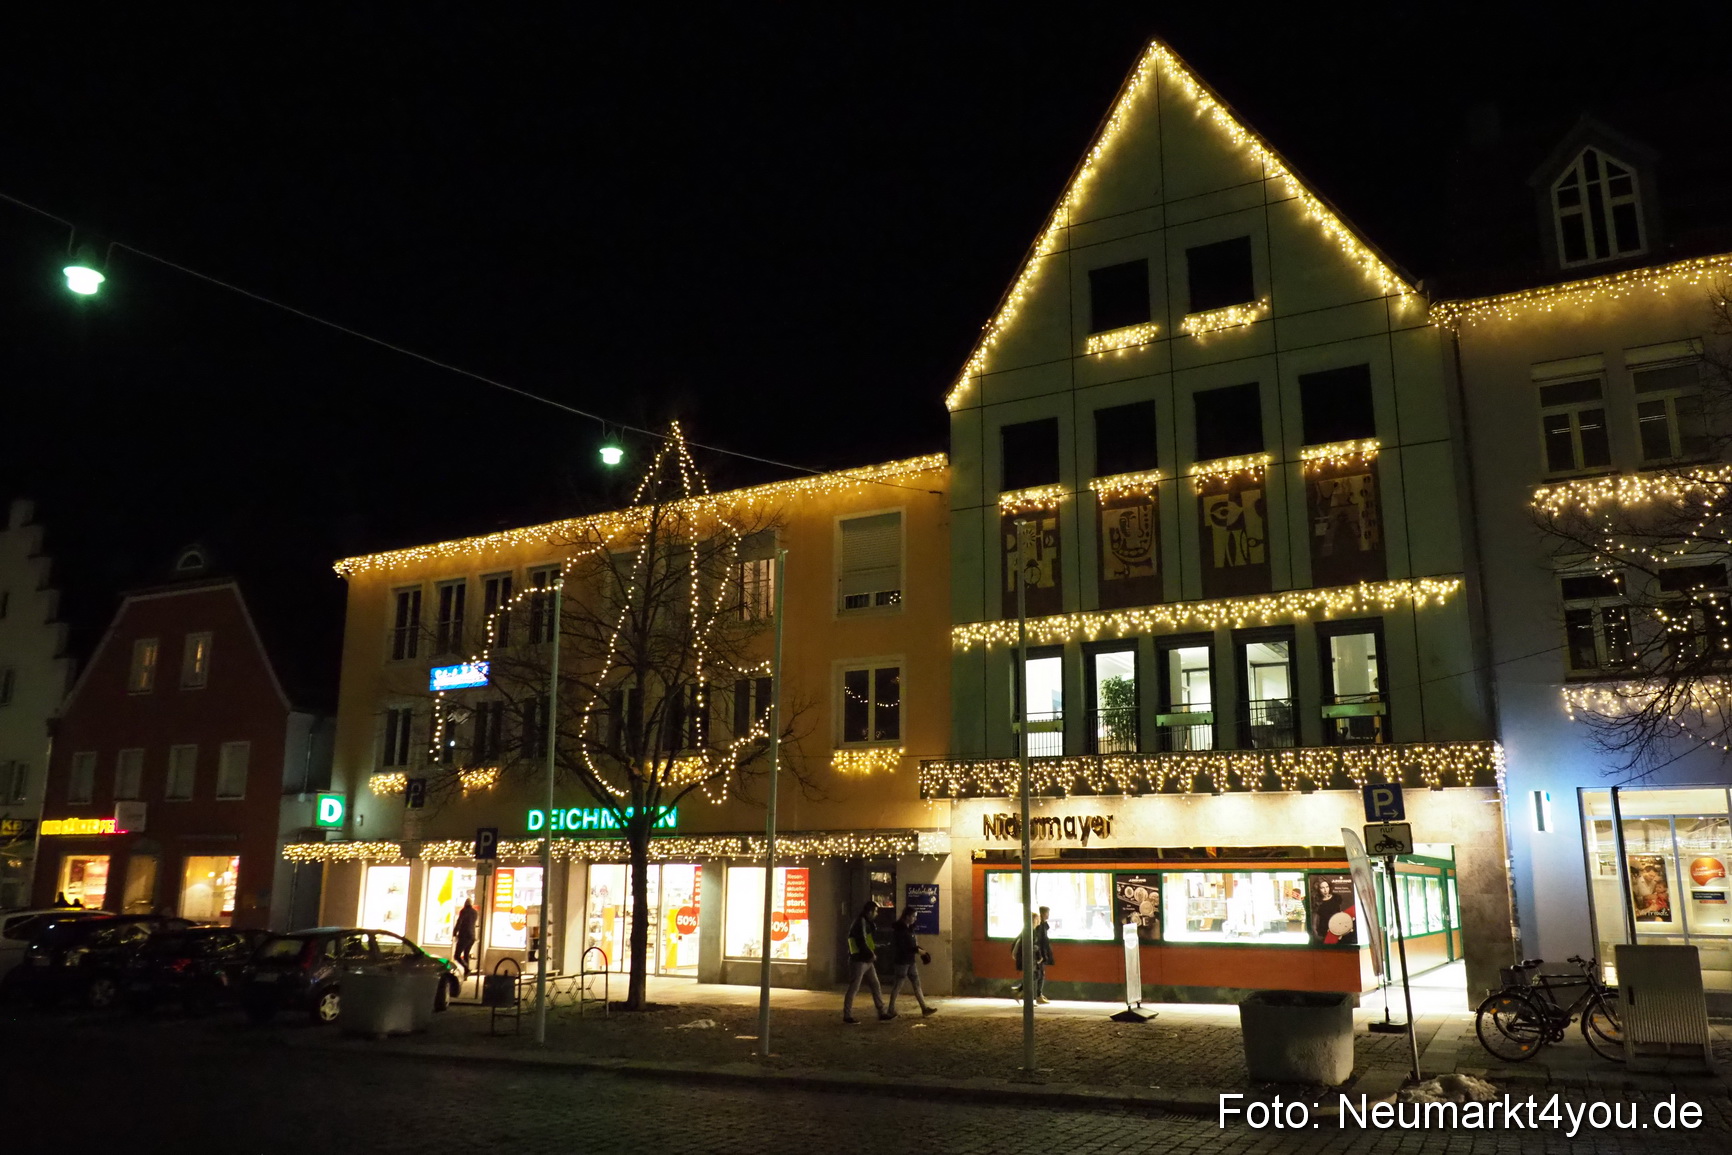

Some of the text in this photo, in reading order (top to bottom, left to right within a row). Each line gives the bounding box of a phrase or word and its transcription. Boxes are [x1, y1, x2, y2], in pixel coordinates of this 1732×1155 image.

[320, 798, 343, 823] D
[1372, 788, 1394, 818] P
[527, 806, 678, 830] DEICHMN
[480, 831, 494, 856] P
[787, 899, 806, 907] stark
[677, 915, 697, 926] 50%
